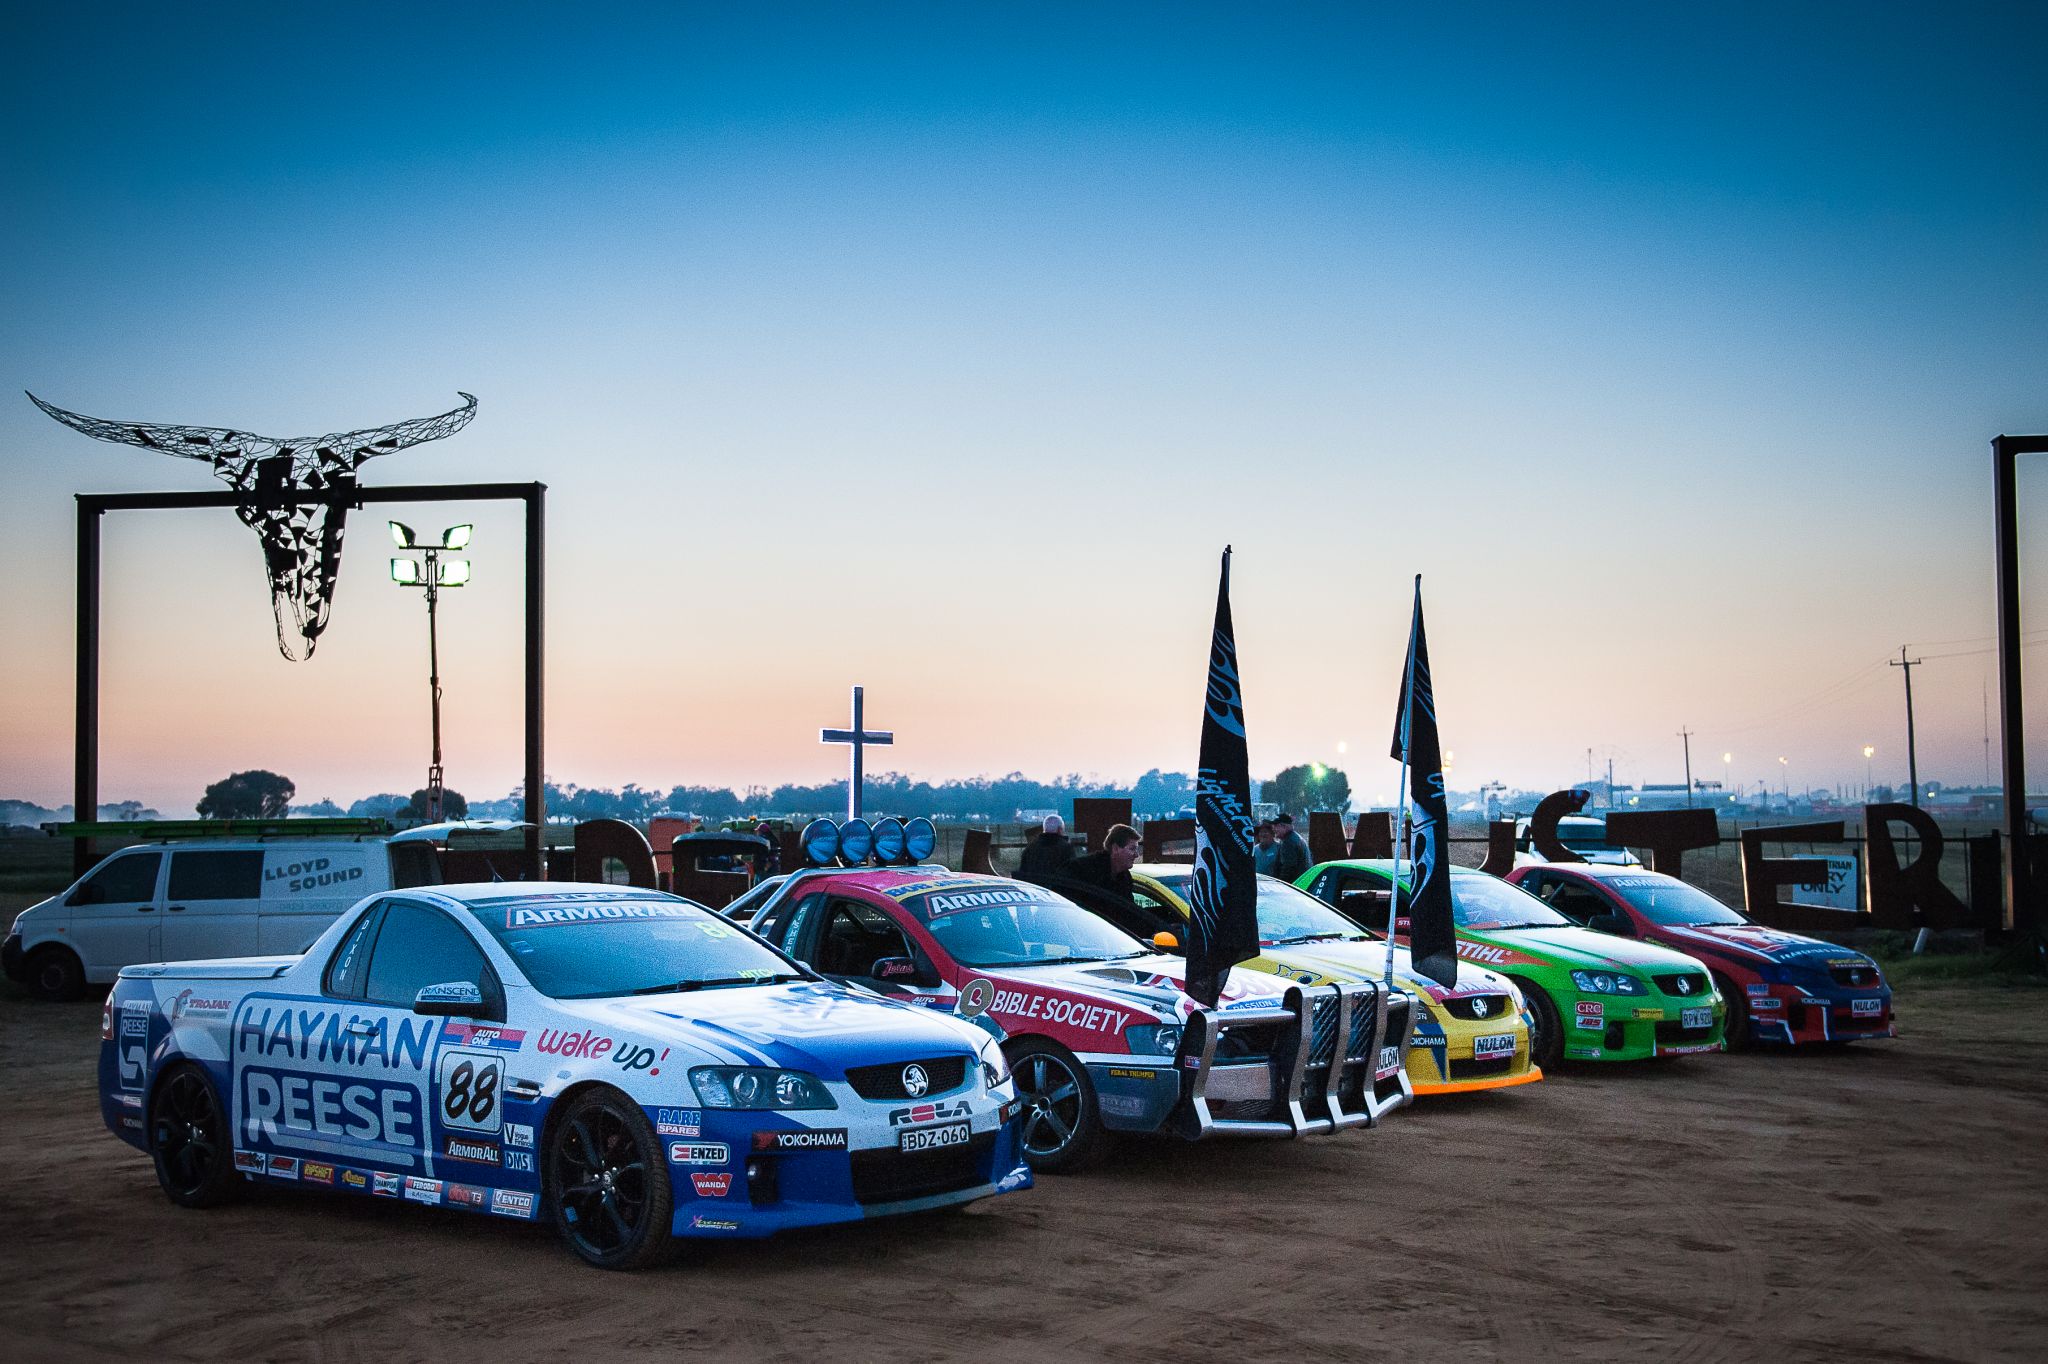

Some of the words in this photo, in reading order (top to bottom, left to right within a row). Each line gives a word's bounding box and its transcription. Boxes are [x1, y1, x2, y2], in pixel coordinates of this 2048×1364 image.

[265, 858, 330, 880] LLOYD
[289, 867, 363, 892] SOUND
[884, 883, 932, 897] BOB
[1801, 882, 1846, 894] ONLY
[340, 920, 370, 981] DIXON
[1456, 940, 1503, 963] STIHL
[421, 987, 480, 996] TRANSCEND
[189, 999, 231, 1009] TROJAN
[1577, 1003, 1602, 1013] CRC
[1854, 1001, 1879, 1011] NULON
[992, 990, 1044, 1021] BIBLE
[1045, 998, 1130, 1035] SOCIETY
[122, 1018, 147, 1037] REESE
[475, 1029, 500, 1039] AUTO
[239, 1006, 434, 1070] HAYMAN
[472, 1037, 490, 1046] ONE
[1410, 1037, 1446, 1046] OKOHAMA
[1476, 1036, 1515, 1053] NULON
[537, 1028, 612, 1060] wake
[613, 1042, 671, 1076] up!
[445, 1060, 498, 1123] 88
[247, 1072, 415, 1147] REESE
[658, 1109, 701, 1125] RARE
[659, 1125, 699, 1135] SPARES
[778, 1133, 845, 1147] YOKOHAMA
[449, 1141, 499, 1162] ARMORALL
[690, 1147, 725, 1160] ENZED
[413, 1181, 435, 1191] FERODO
[697, 1180, 726, 1188] WANDA
[495, 1191, 531, 1206] RENTCO
